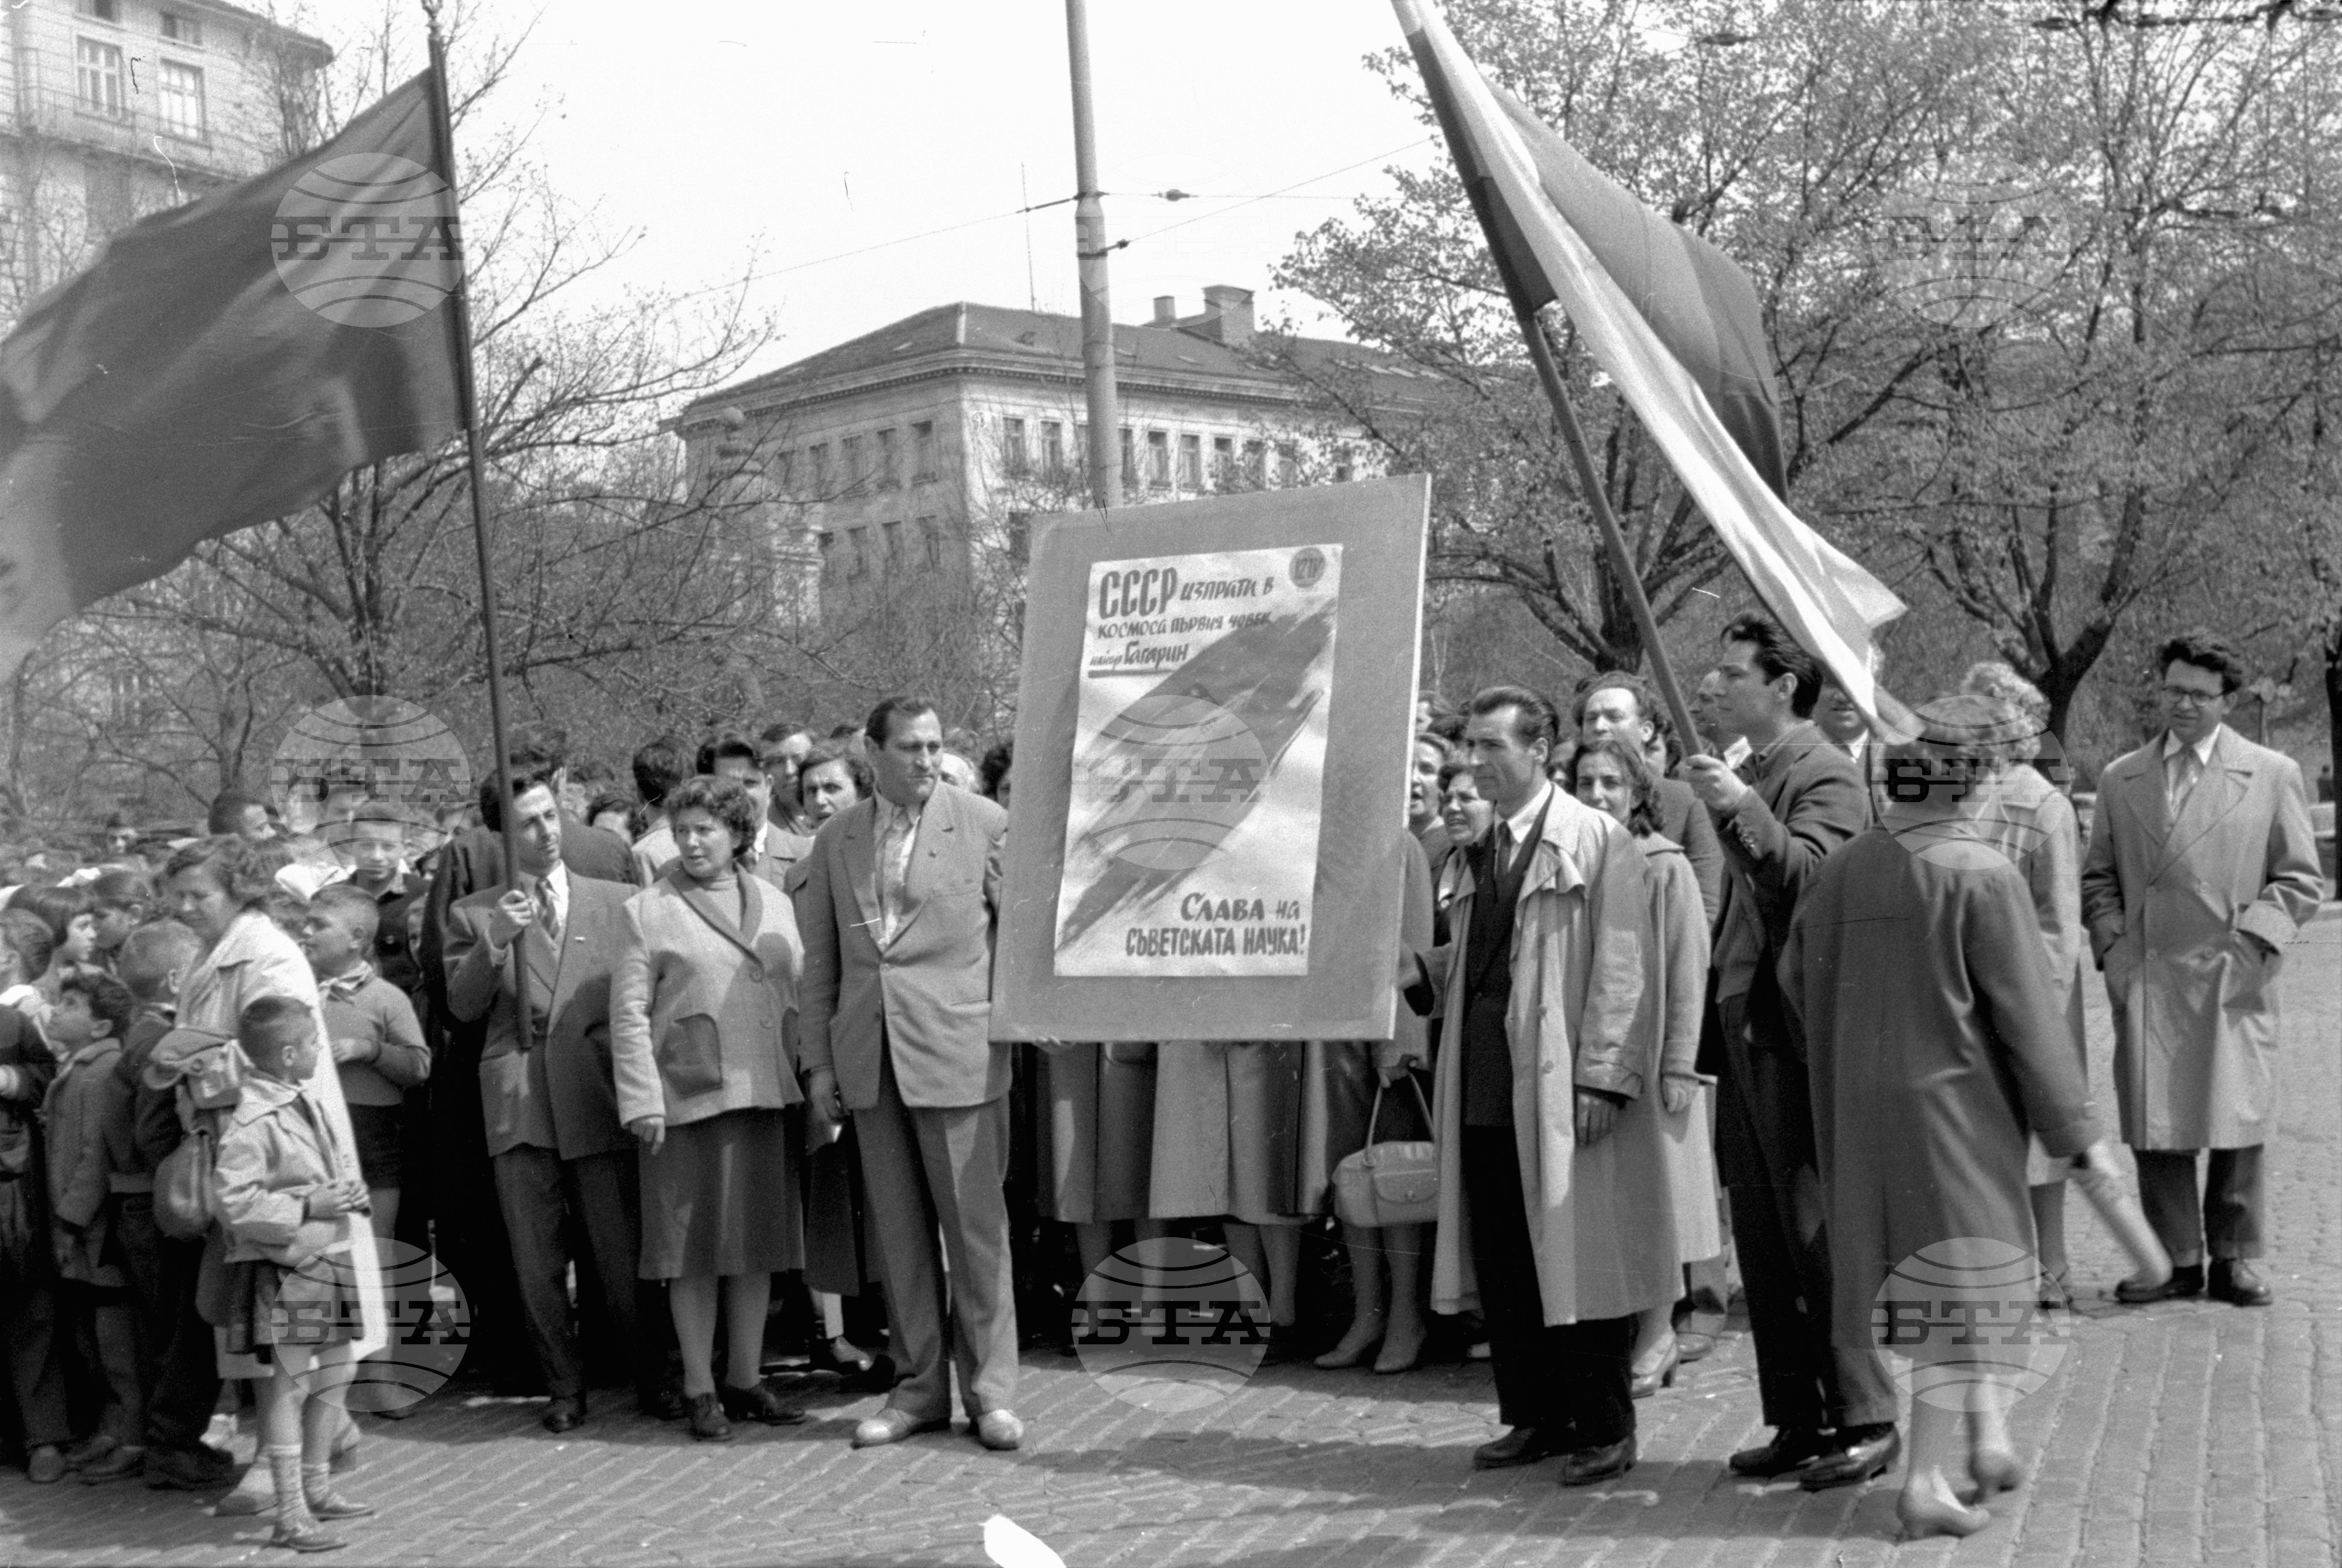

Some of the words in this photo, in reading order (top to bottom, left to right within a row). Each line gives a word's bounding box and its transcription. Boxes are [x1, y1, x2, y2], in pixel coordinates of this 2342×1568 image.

[1098, 567, 1177, 619] СССР
[1098, 619, 1166, 639] космоса
[1170, 616, 1223, 633] първия
[1229, 611, 1272, 628] човек
[1124, 640, 1189, 670] Гагарин
[1276, 899, 1300, 920] на
[1125, 927, 1237, 957] СЪВЕТСКАТА
[1242, 923, 1306, 956] НАУКА!
